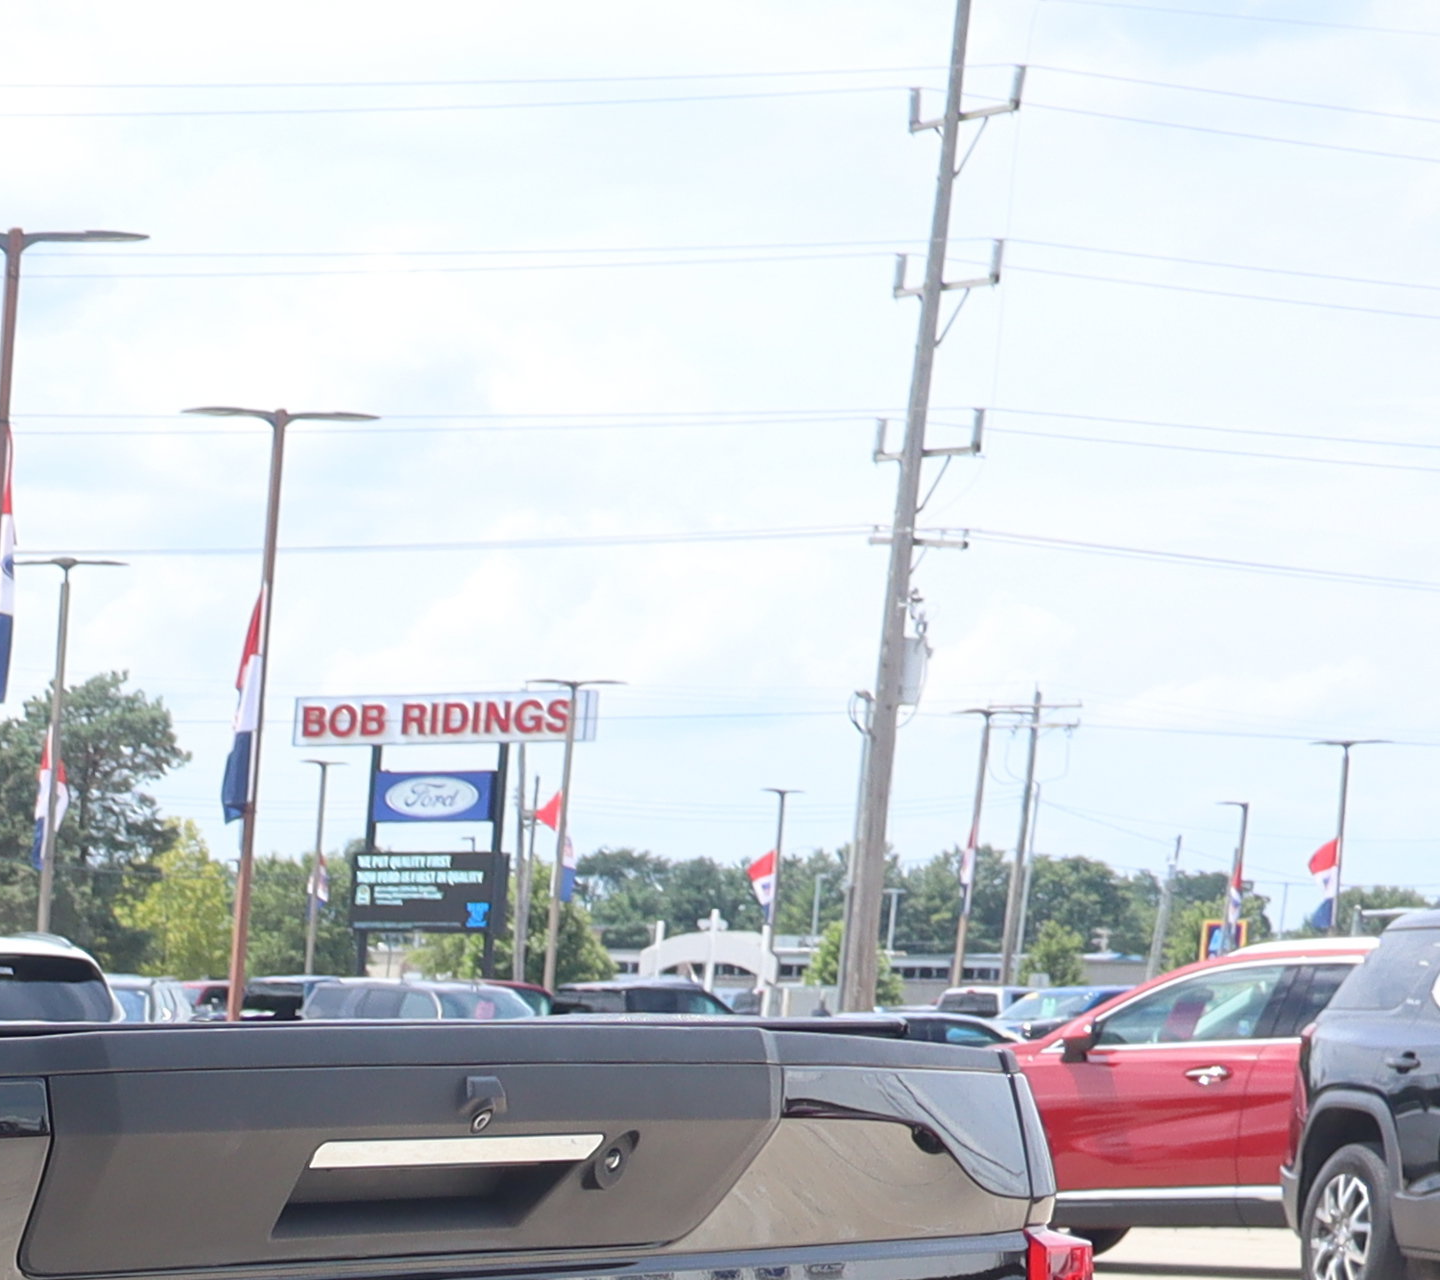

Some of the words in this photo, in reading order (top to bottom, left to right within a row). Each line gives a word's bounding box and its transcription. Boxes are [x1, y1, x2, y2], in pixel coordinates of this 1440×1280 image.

[302, 704, 387, 738] BOB
[401, 698, 572, 736] RIDINGS
[404, 782, 460, 809] Ford
